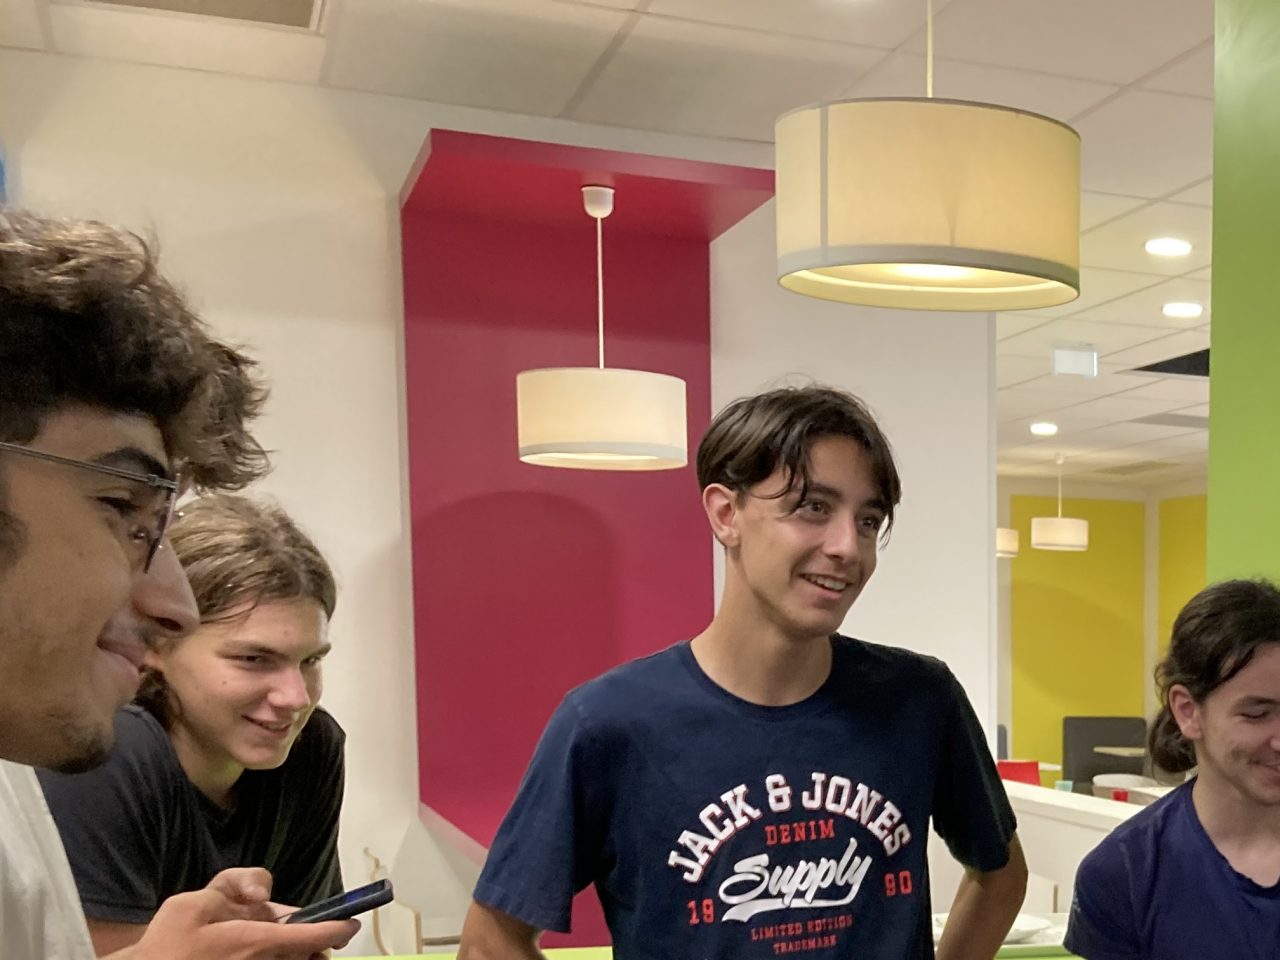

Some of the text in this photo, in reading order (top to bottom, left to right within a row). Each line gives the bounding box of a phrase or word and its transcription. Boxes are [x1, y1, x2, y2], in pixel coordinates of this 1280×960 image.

[667, 771, 913, 884] JACK & JONES
[763, 818, 836, 847] DENIM
[718, 837, 873, 908] Supply
[687, 898, 716, 926] 19
[751, 922, 803, 941] LIMITED
[772, 934, 838, 955] TRADEMARK
